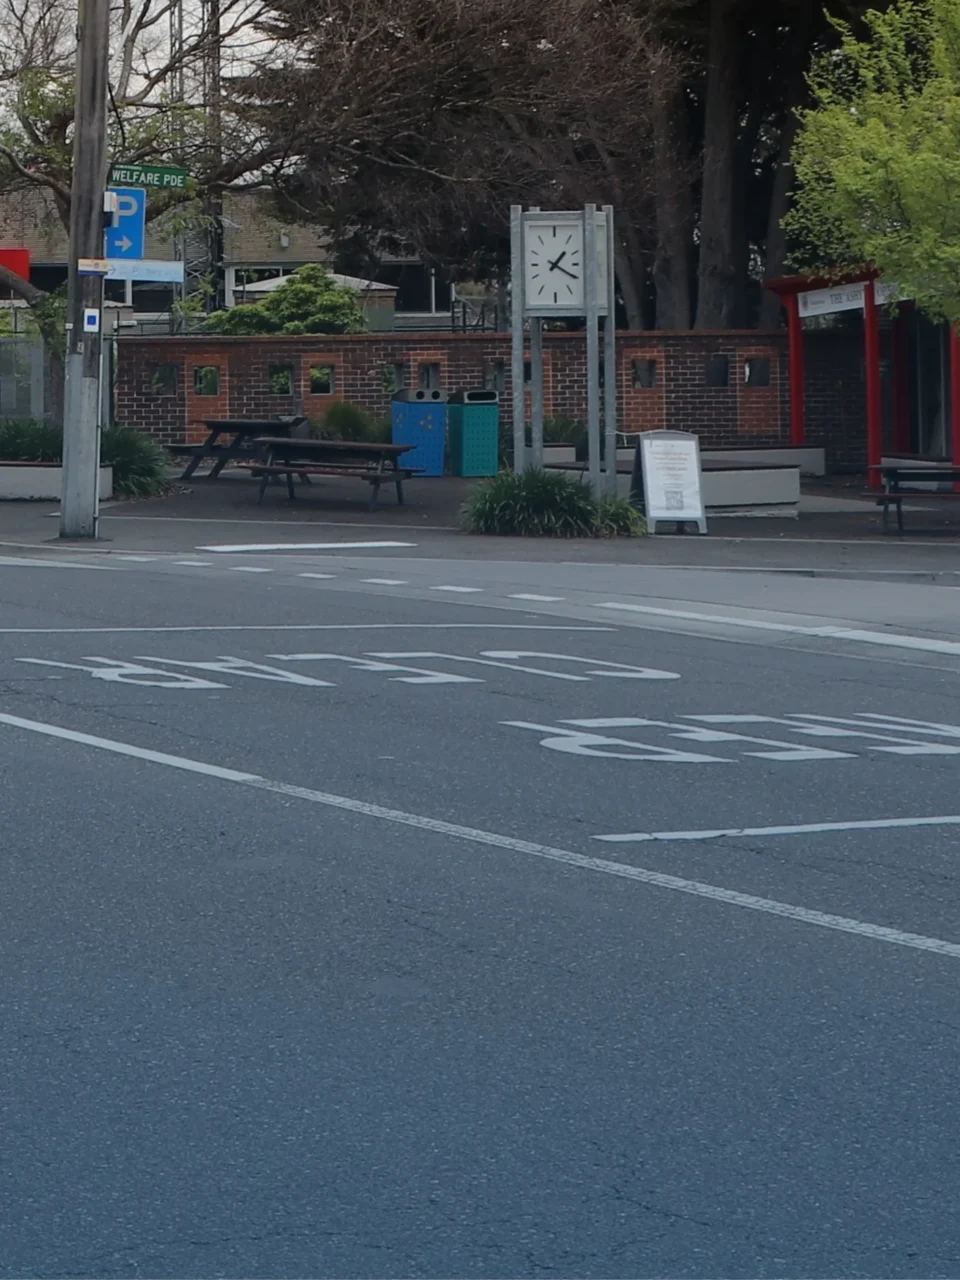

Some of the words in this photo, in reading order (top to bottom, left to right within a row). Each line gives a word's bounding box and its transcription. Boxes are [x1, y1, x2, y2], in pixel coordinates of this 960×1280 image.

[112, 169, 160, 185] WELFARE
[163, 175, 184, 187] PDE
[111, 195, 138, 228] P
[14, 650, 682, 688] CLEAR
